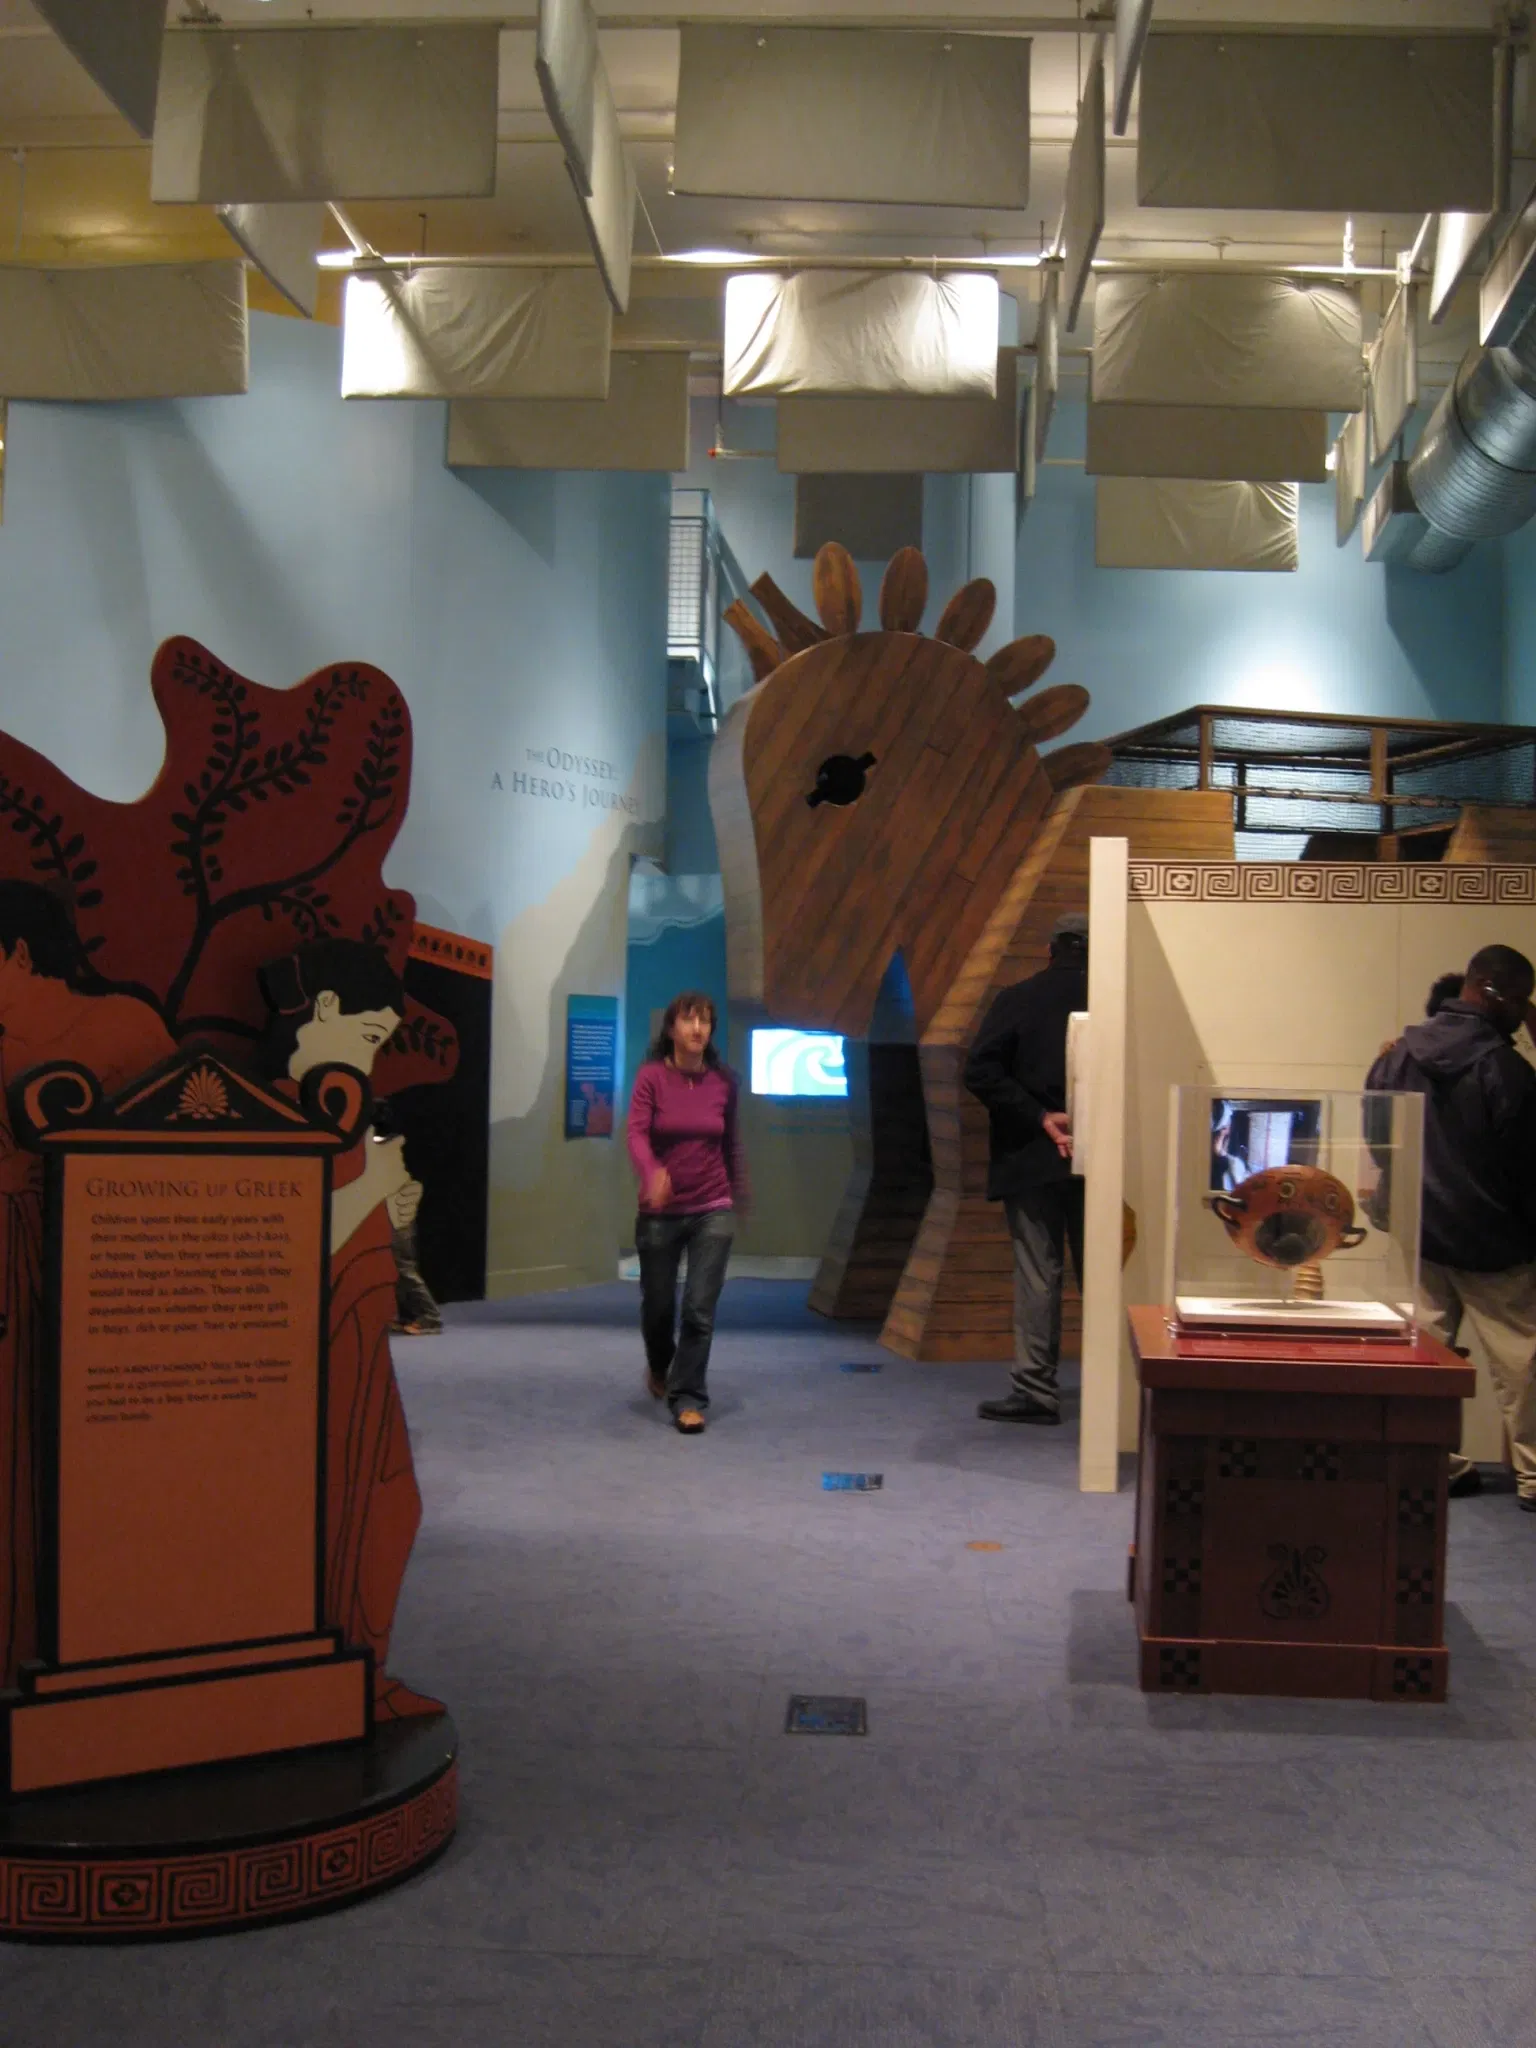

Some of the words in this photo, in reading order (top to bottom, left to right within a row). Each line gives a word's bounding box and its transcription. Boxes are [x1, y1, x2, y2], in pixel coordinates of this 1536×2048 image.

[526, 748, 544, 762] THE
[491, 771, 503, 790] A
[512, 771, 576, 802] HERO'S
[86, 1177, 198, 1198] GROWING
[206, 1184, 228, 1197] UP
[235, 1179, 303, 1198] GREEK
[92, 1214, 137, 1225] Children
[202, 1214, 227, 1225] early
[232, 1215, 258, 1225] years
[263, 1213, 284, 1223] with
[168, 1230, 178, 1241] in
[182, 1232, 200, 1241] the
[90, 1252, 103, 1260] or
[144, 1249, 173, 1260] When
[178, 1249, 201, 1261] they
[205, 1251, 230, 1259] were
[234, 1249, 264, 1259] about
[90, 1268, 134, 1279] children
[137, 1268, 170, 1280] began
[173, 1268, 217, 1279] learning
[220, 1267, 237, 1276] the
[241, 1266, 265, 1276] skills
[269, 1267, 291, 1277] they
[89, 1287, 124, 1297] would
[127, 1286, 154, 1296] need
[88, 1305, 144, 1316] depended
[147, 1306, 161, 1314] on
[165, 1305, 210, 1313] whether
[212, 1302, 236, 1313] they
[239, 1304, 265, 1312] were
[158, 1324, 170, 1332] or
[229, 1321, 238, 1329] or
